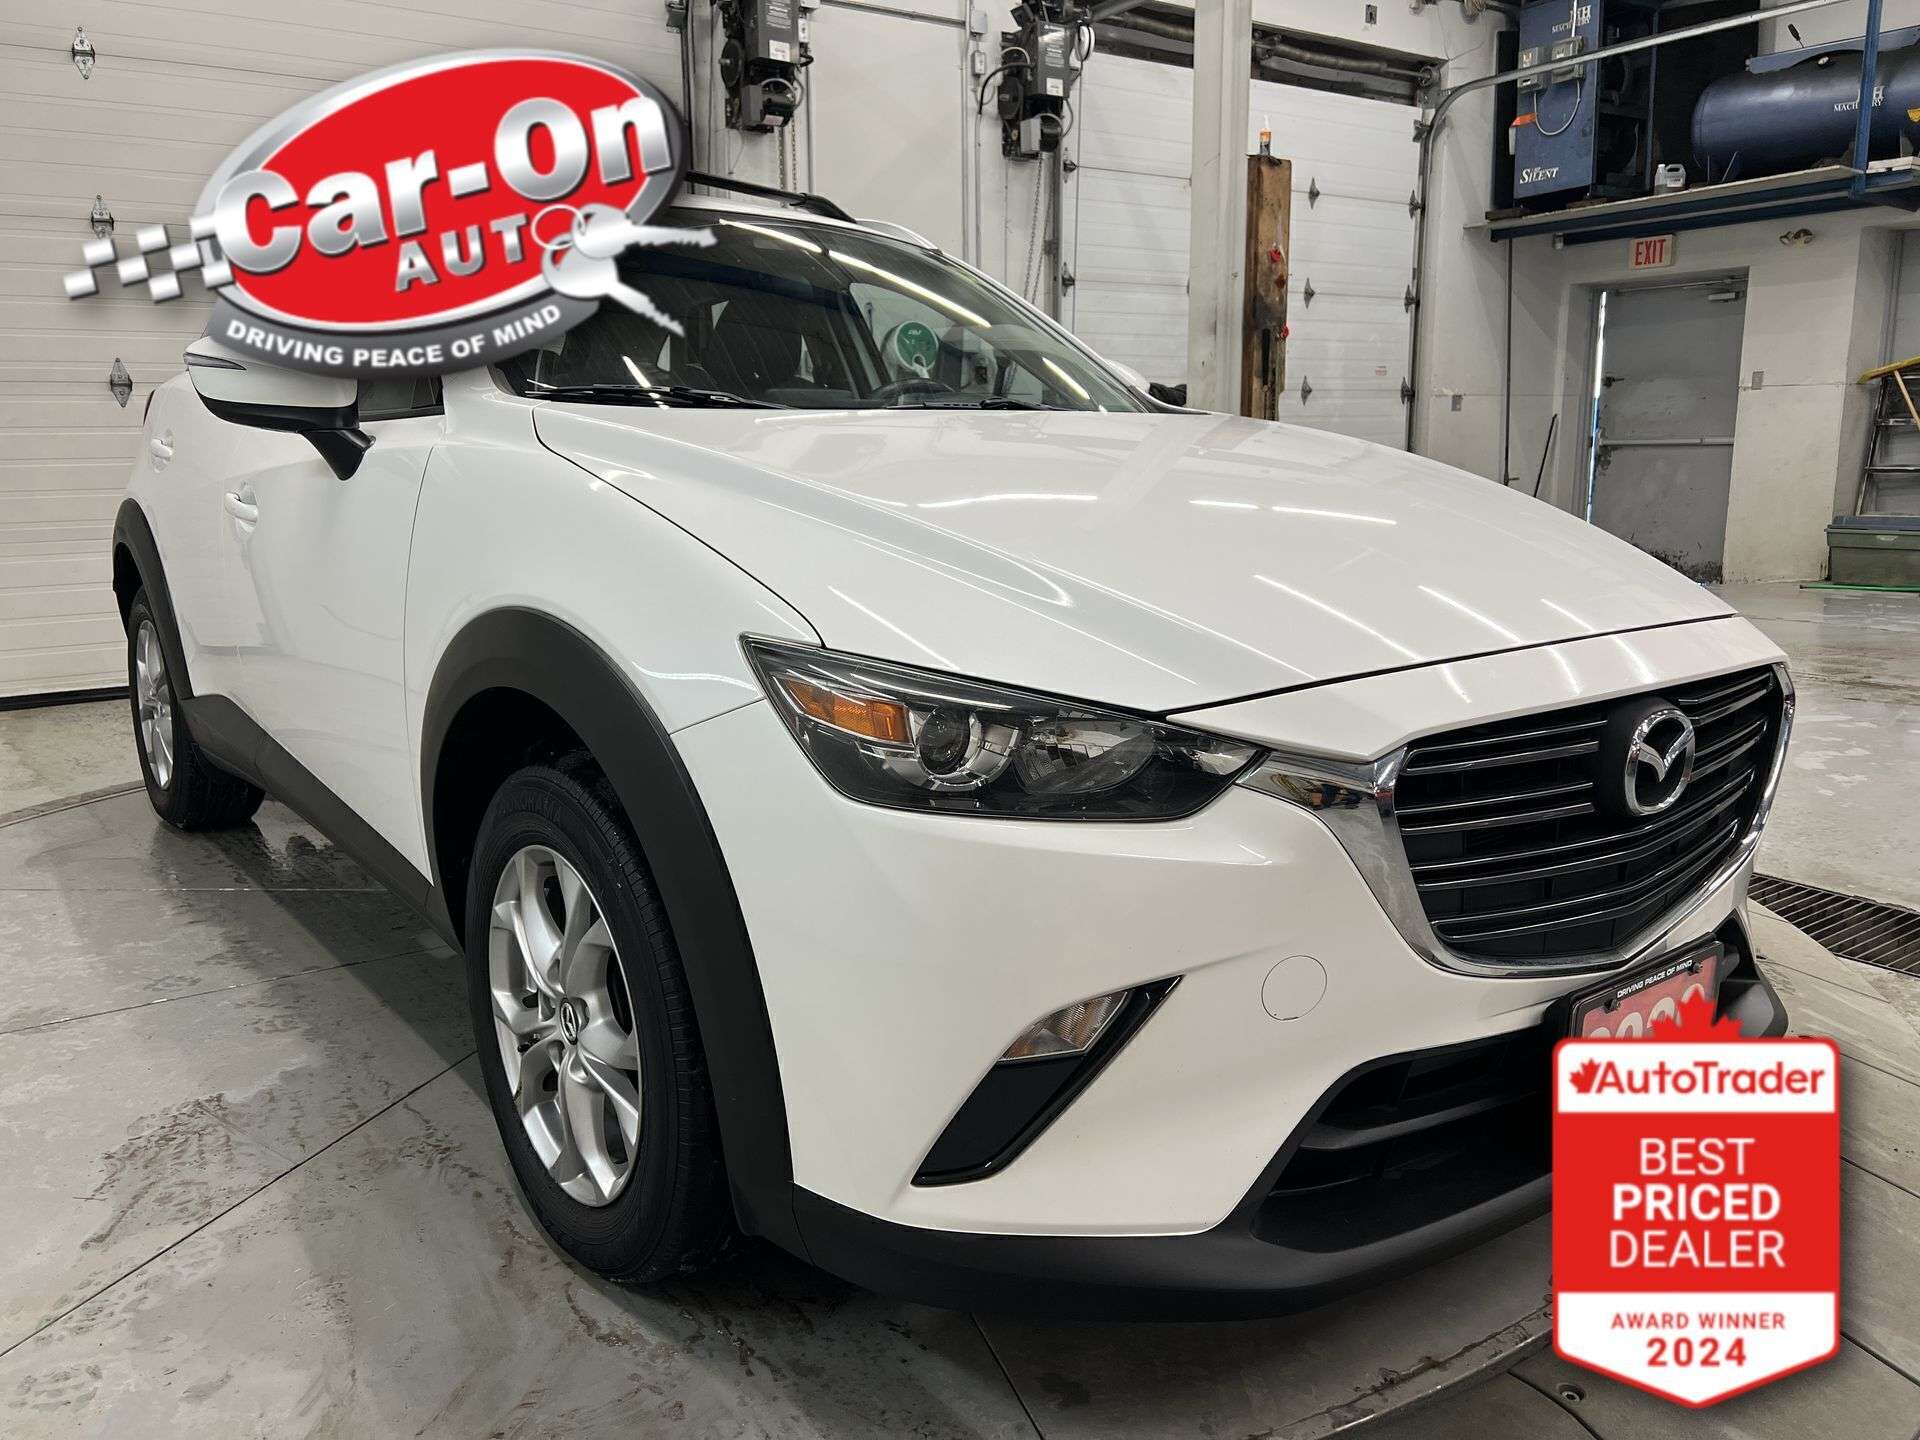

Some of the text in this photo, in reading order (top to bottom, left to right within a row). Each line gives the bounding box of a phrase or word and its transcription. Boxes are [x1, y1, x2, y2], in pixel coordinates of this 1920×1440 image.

[1635, 239, 1666, 266] EXIT
[1616, 959, 1693, 998] DRIVING PEACE OF MIND
